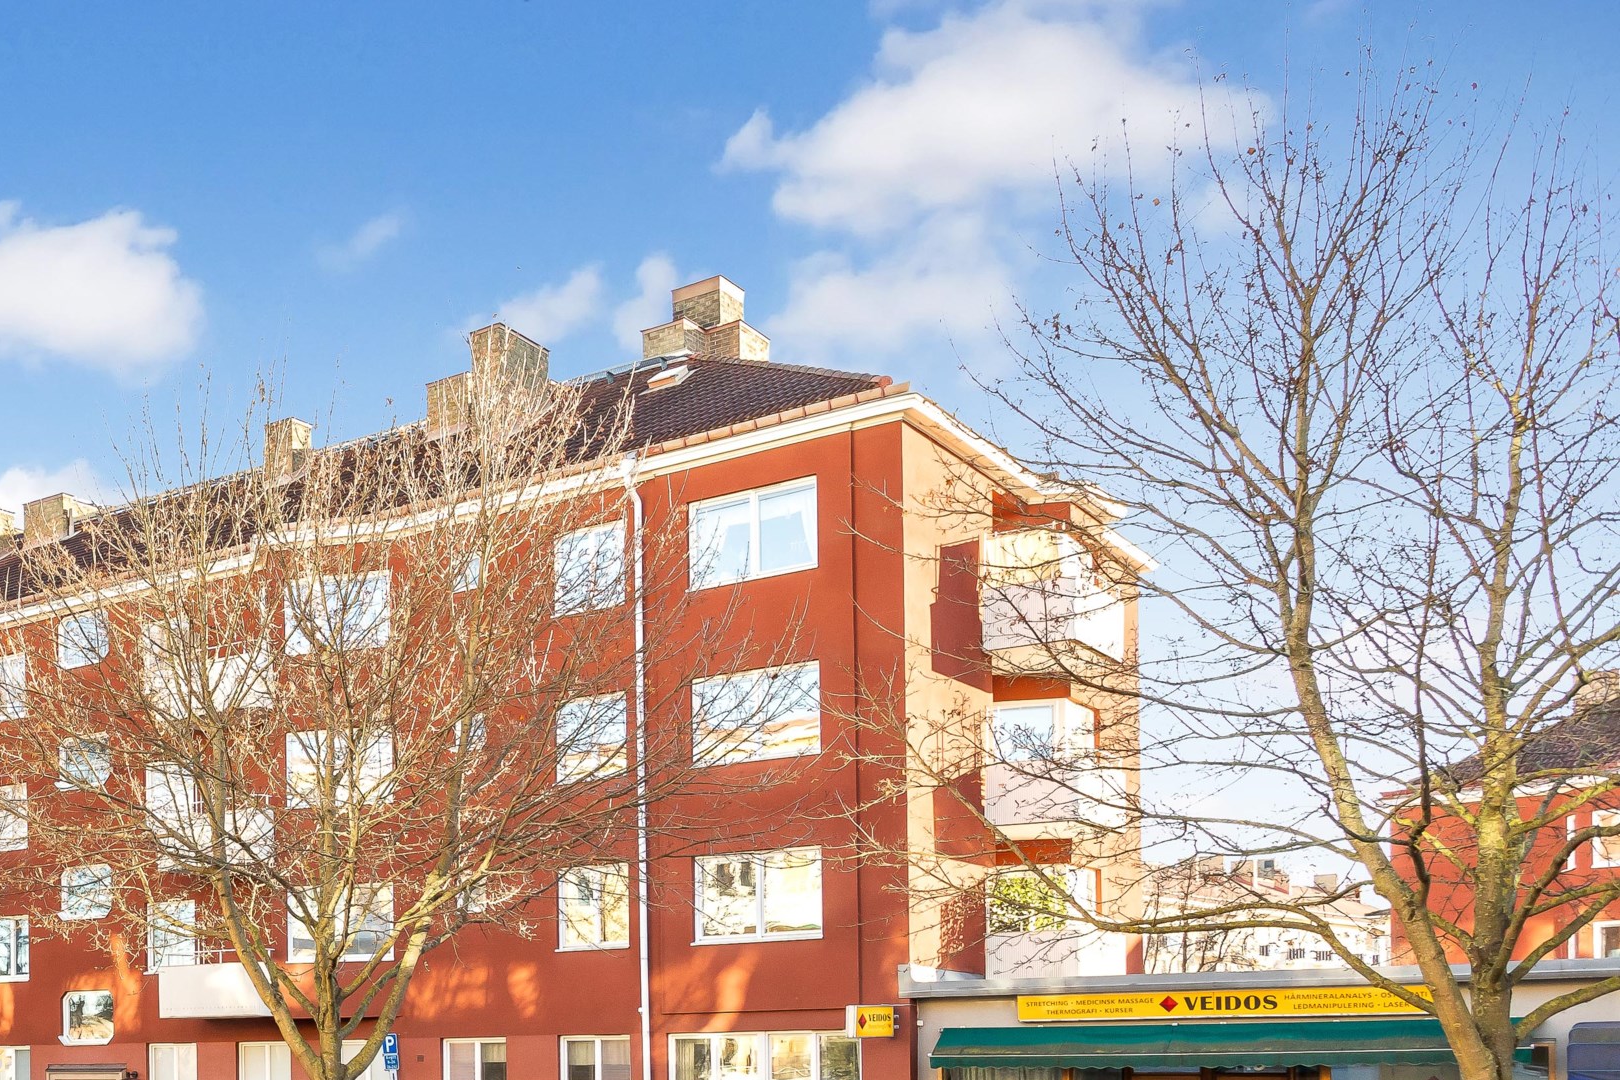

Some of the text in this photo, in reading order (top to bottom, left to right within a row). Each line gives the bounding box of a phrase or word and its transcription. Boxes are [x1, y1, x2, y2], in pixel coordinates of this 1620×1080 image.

[1284, 992, 1372, 1000] HÅRMINERALANALYS
[1117, 997, 1154, 1005] MASSAGE
[1183, 995, 1278, 1011] VEIDOS
[1293, 1002, 1375, 1010] LEDMANIPULERING
[385, 1036, 394, 1052] P
